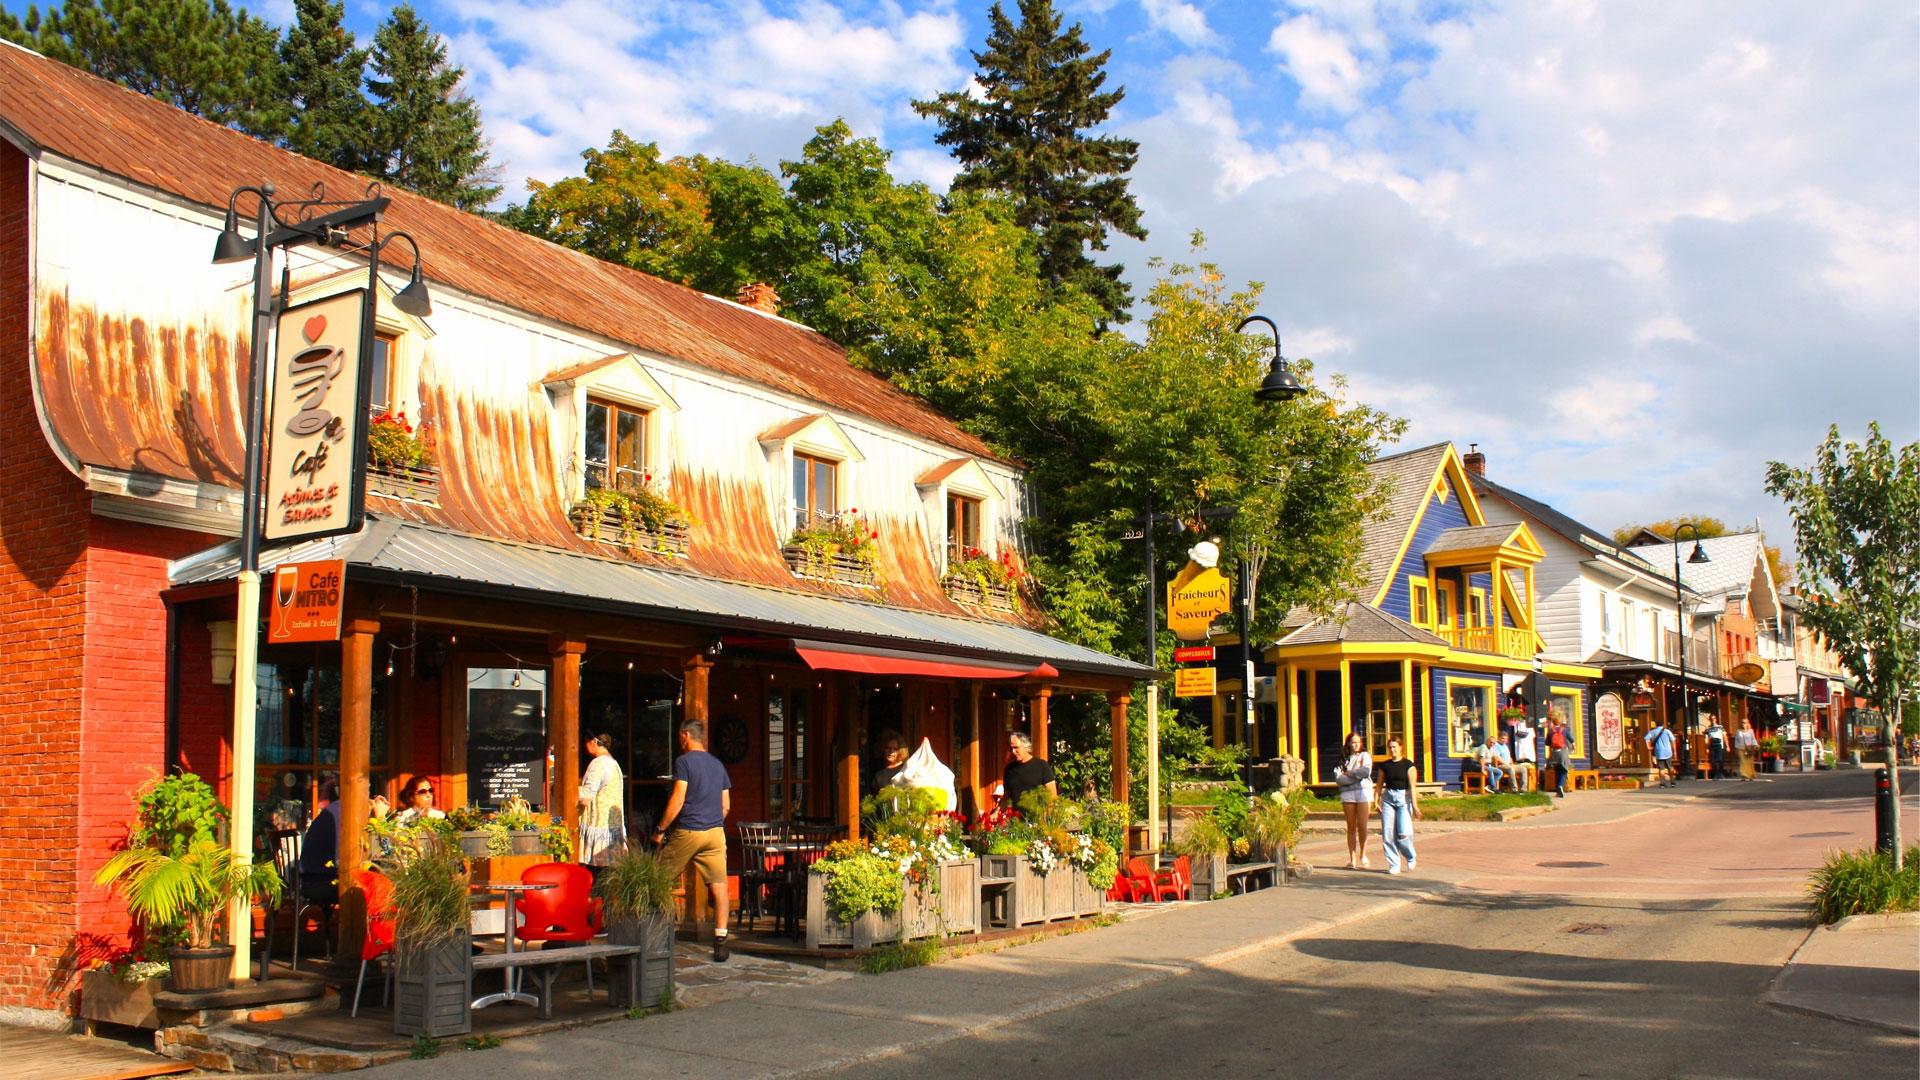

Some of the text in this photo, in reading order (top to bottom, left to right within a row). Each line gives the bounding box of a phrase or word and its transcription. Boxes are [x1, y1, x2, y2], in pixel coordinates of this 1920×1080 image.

[293, 441, 329, 485] Café
[310, 572, 339, 589] Café
[296, 589, 339, 608] NITRO
[320, 618, 337, 627] froid
